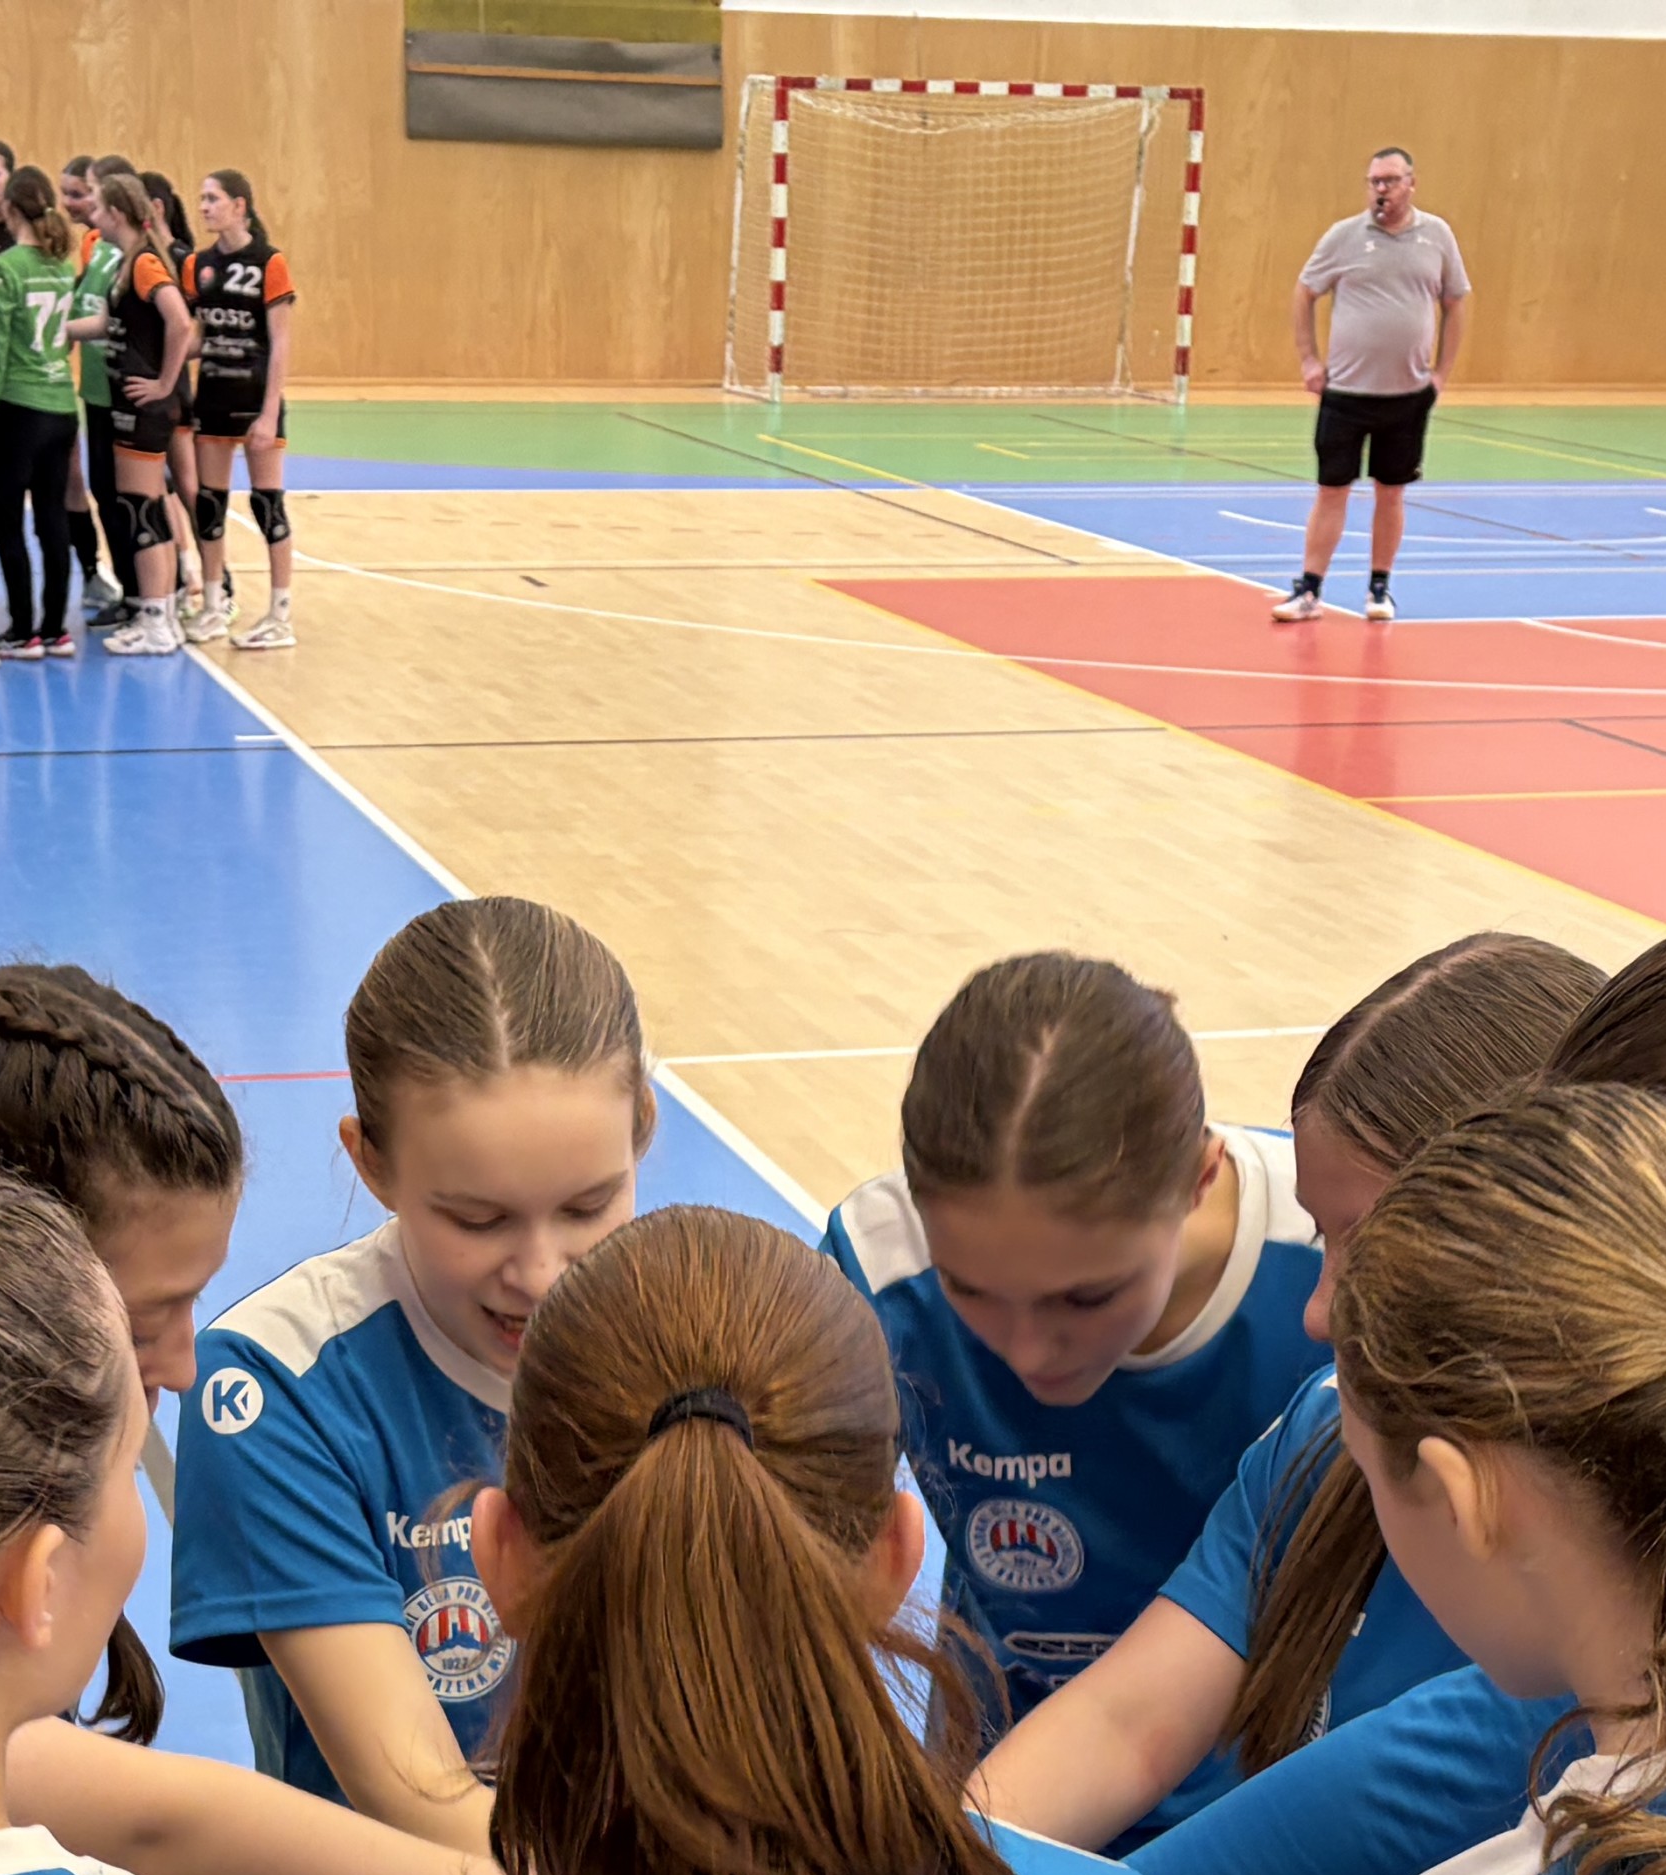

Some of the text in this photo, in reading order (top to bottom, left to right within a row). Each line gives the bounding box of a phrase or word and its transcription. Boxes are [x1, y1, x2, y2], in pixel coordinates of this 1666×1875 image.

[223, 262, 263, 295] 22
[25, 291, 74, 352] 71
[947, 1438, 1072, 1488] Kempa
[386, 1510, 473, 1552] Kemp
